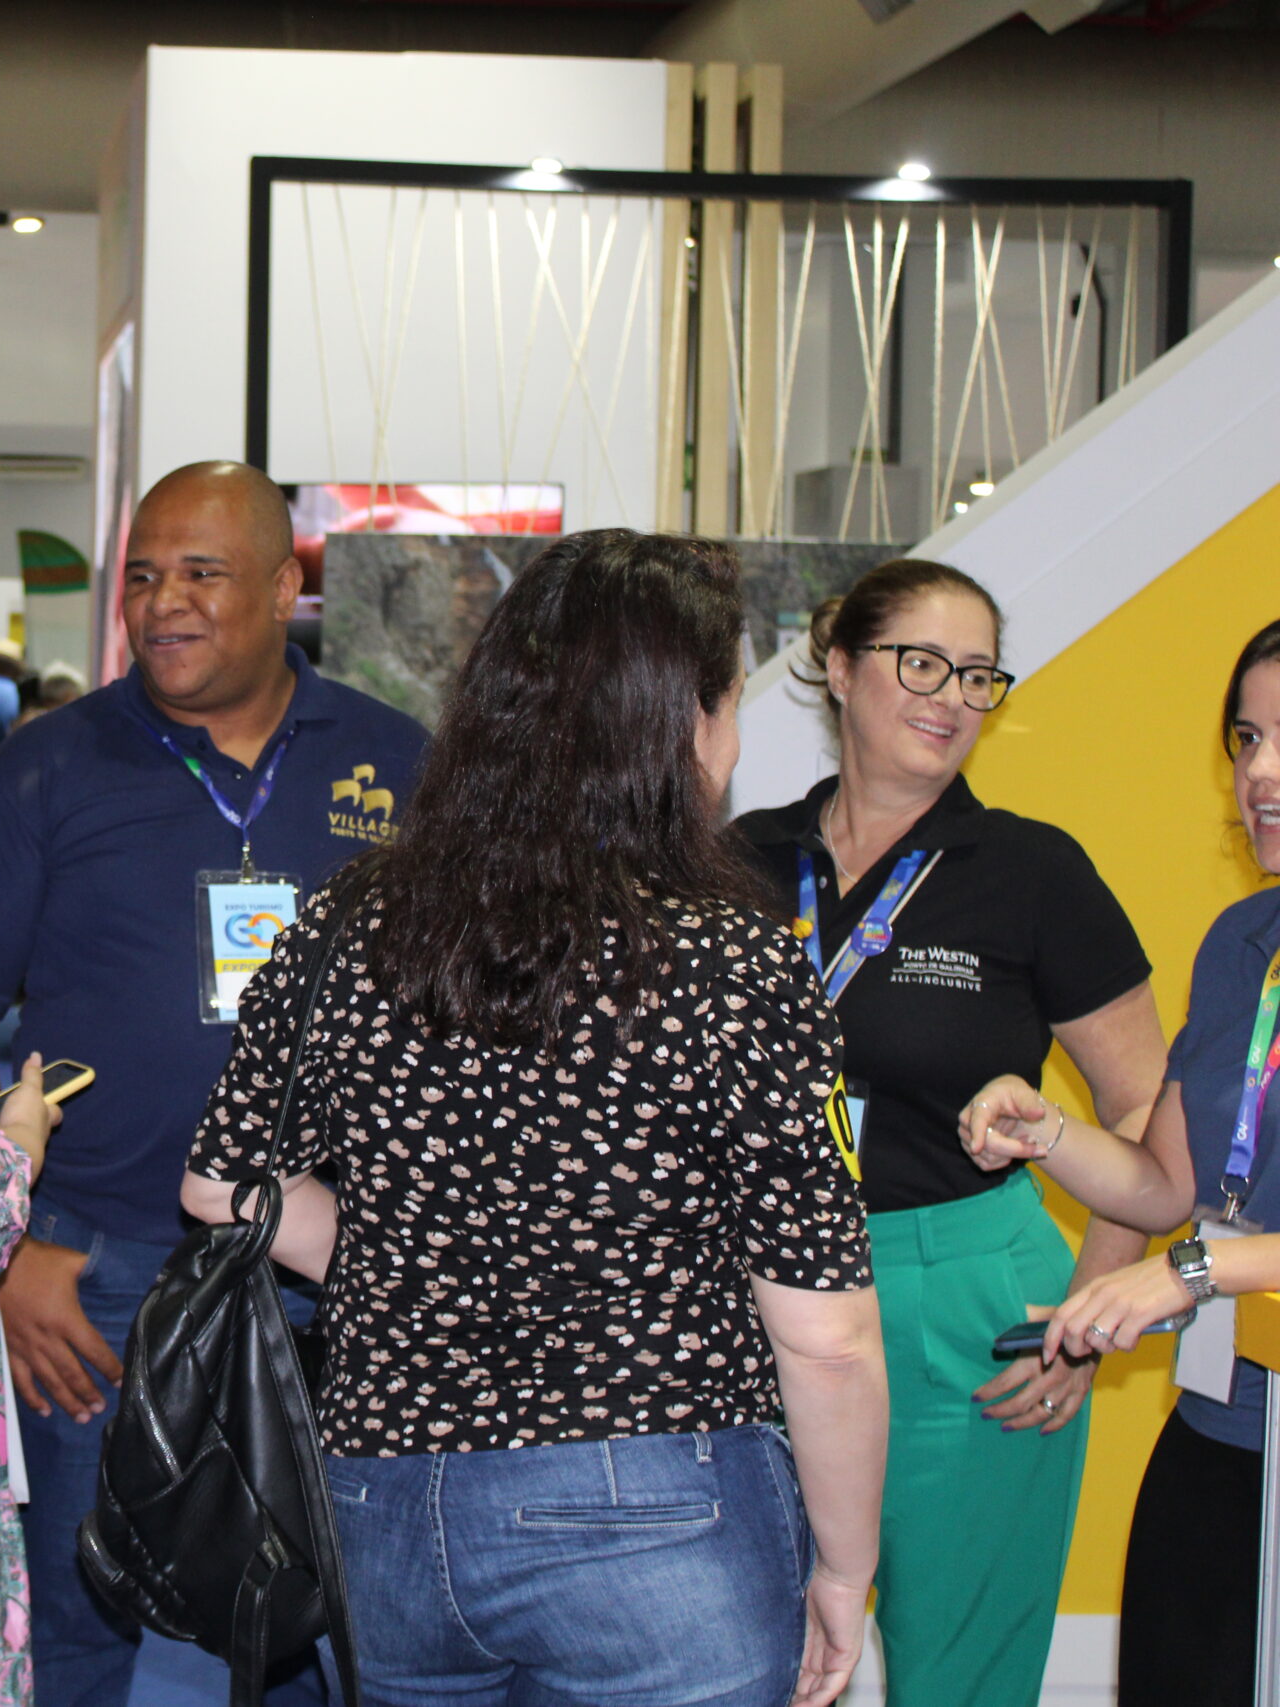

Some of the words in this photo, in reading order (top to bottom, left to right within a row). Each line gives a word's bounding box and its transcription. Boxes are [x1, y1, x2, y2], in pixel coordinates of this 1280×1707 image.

[898, 945, 927, 961] THE
[927, 944, 980, 968] WESTIN
[890, 973, 982, 992] ALL-INCLUSIVE
